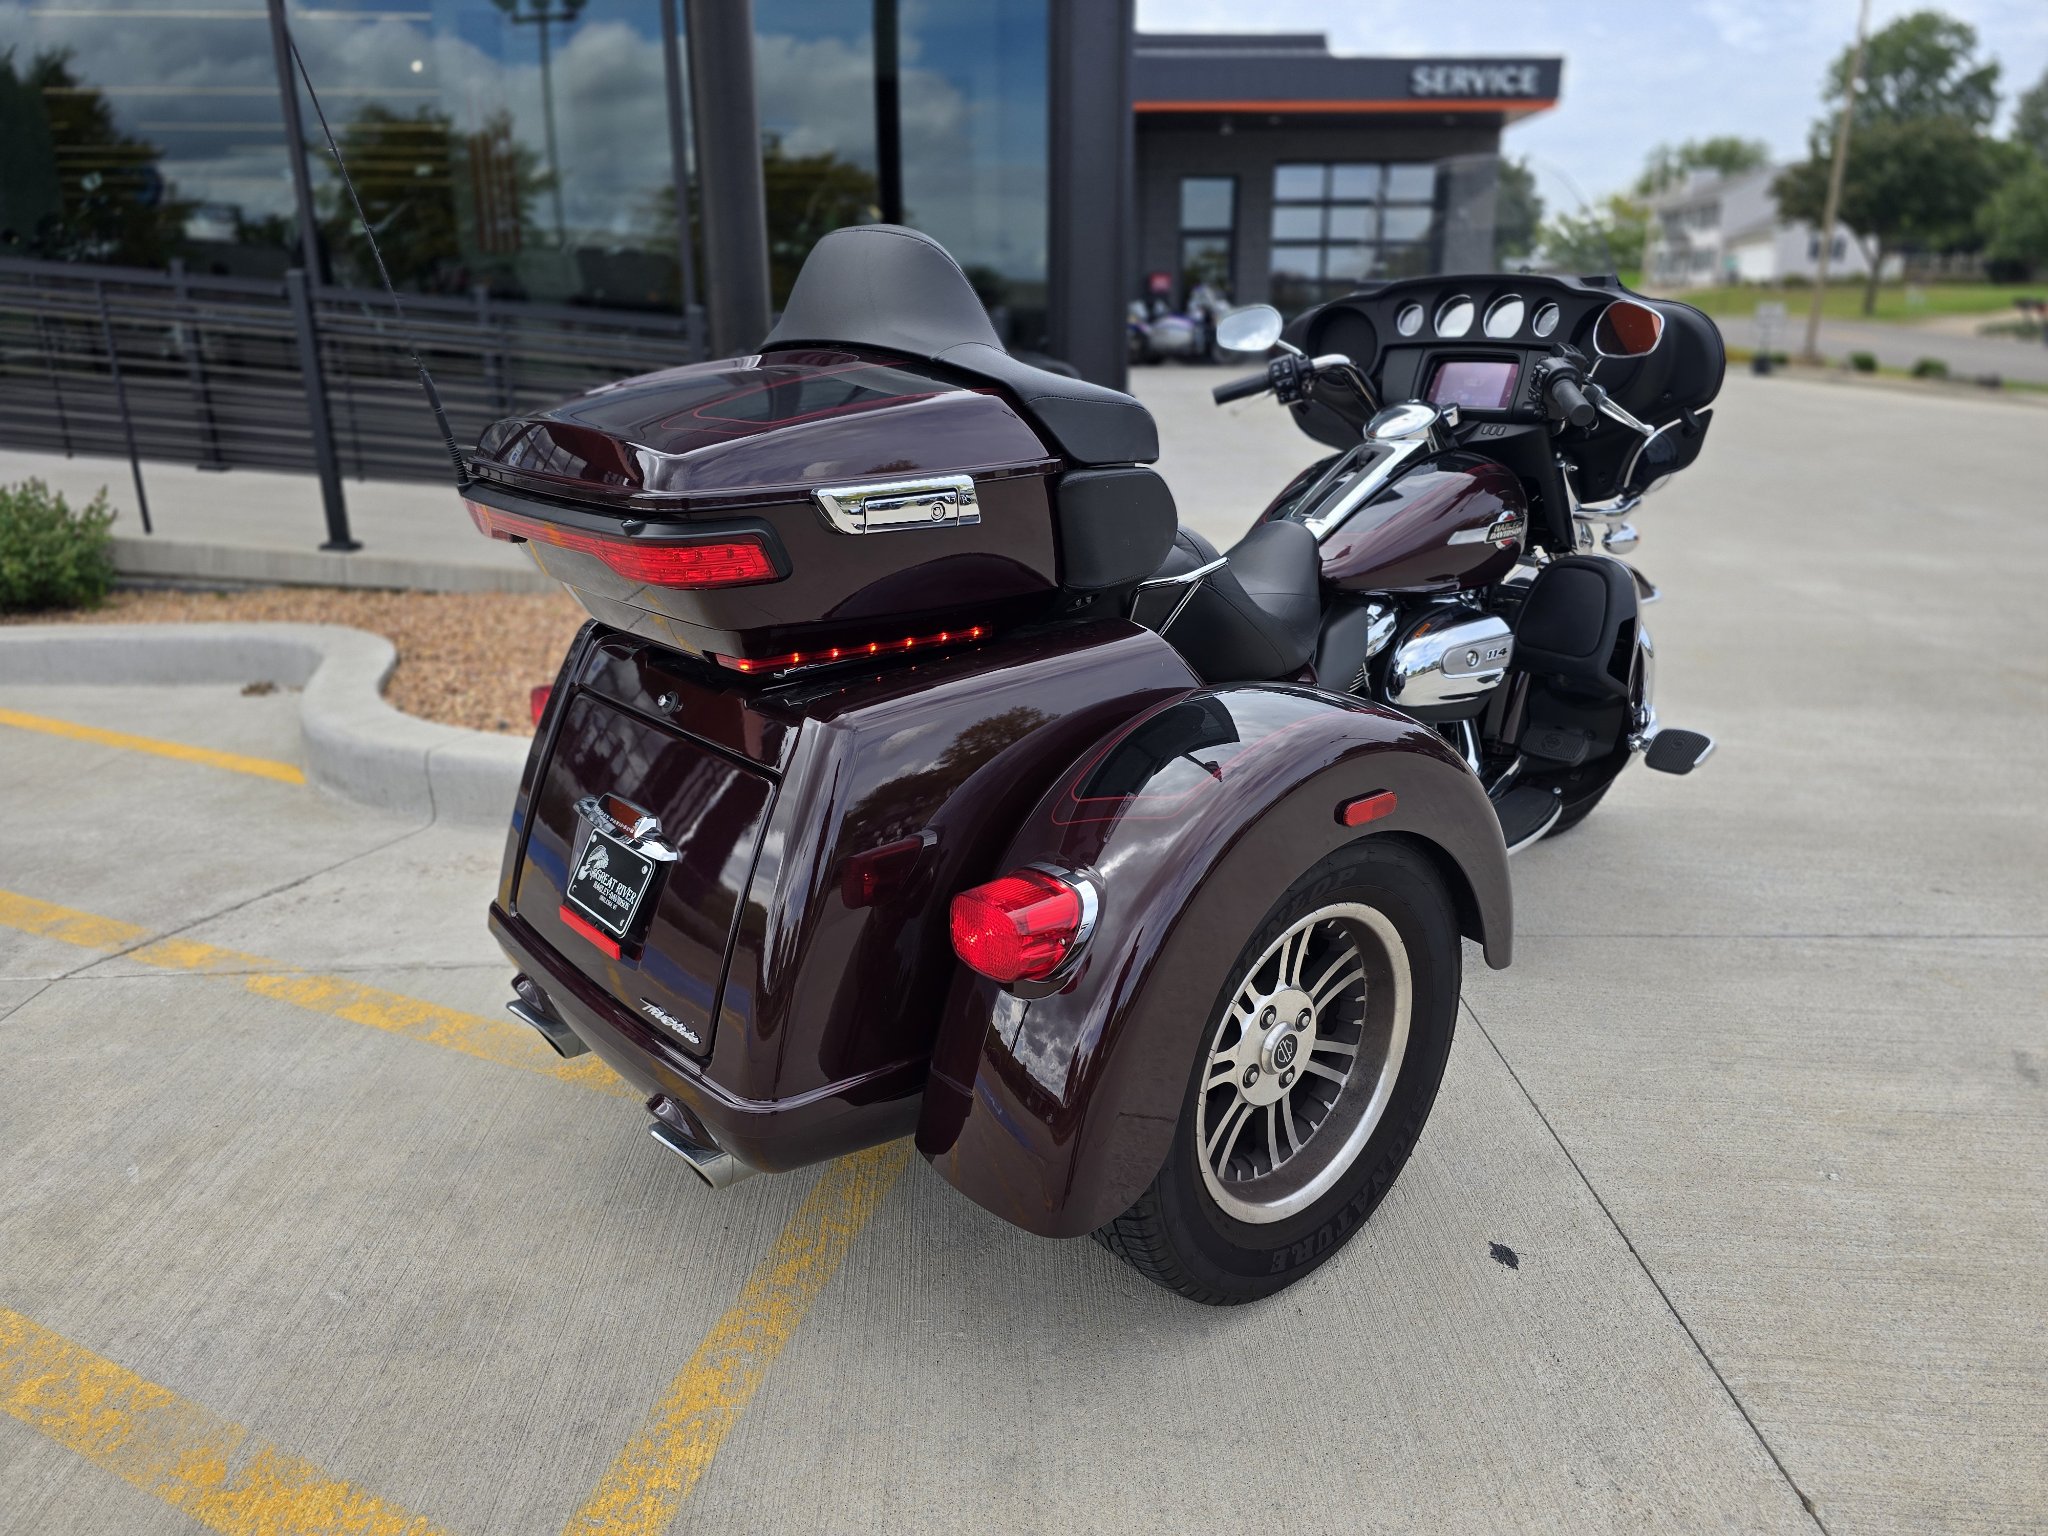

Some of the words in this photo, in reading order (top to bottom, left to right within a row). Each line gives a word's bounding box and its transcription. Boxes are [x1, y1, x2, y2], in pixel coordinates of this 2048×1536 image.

[1411, 65, 1539, 95] SERVICE
[1486, 647, 1508, 660] 114
[595, 868, 618, 889] GREAT
[615, 882, 637, 905] RIVER
